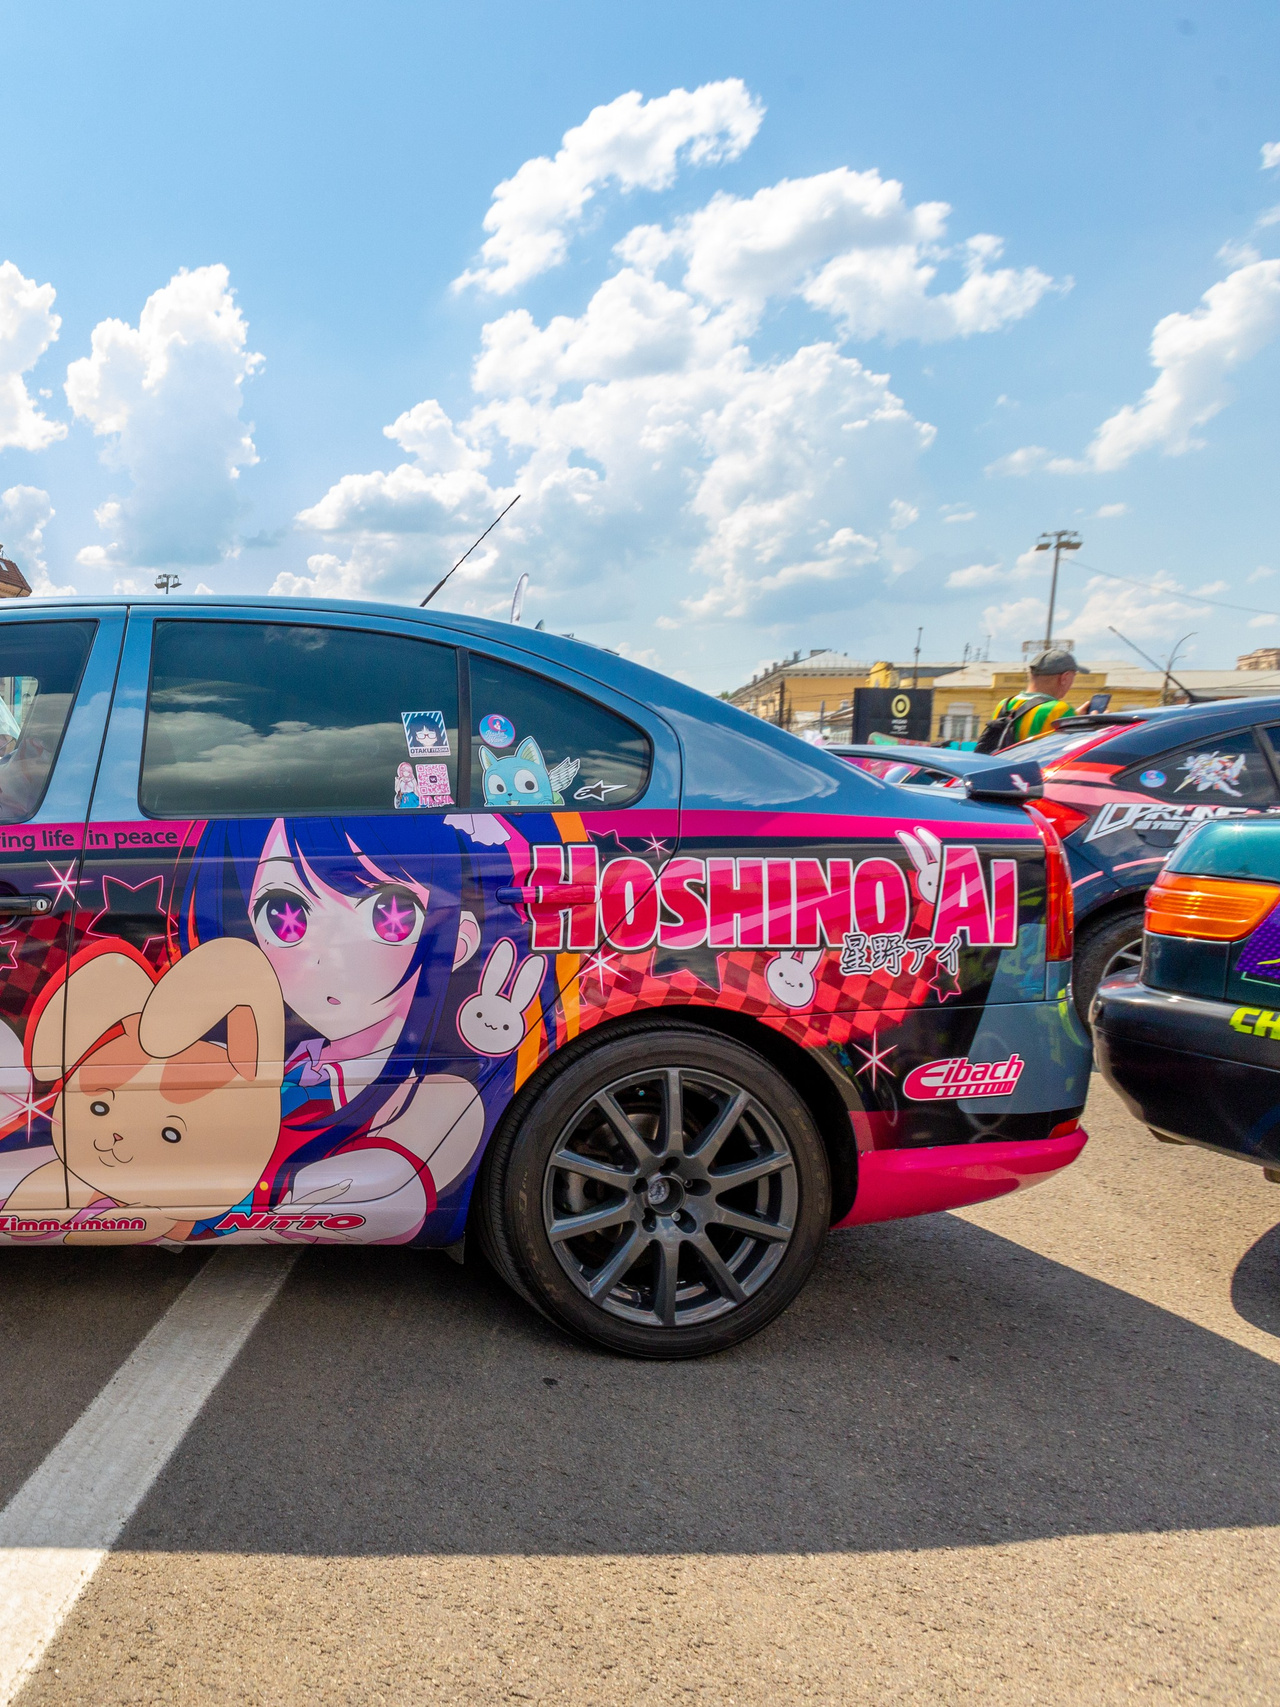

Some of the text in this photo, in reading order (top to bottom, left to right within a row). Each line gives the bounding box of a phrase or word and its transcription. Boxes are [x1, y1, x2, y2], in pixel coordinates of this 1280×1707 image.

[42, 829, 75, 847] life
[88, 830, 108, 846] in
[114, 830, 178, 849] peace
[529, 842, 1019, 951] HOSHINO AI
[839, 931, 961, 977] 星野アイ
[902, 1052, 1025, 1101] Eibach
[213, 1212, 367, 1231] NITTO
